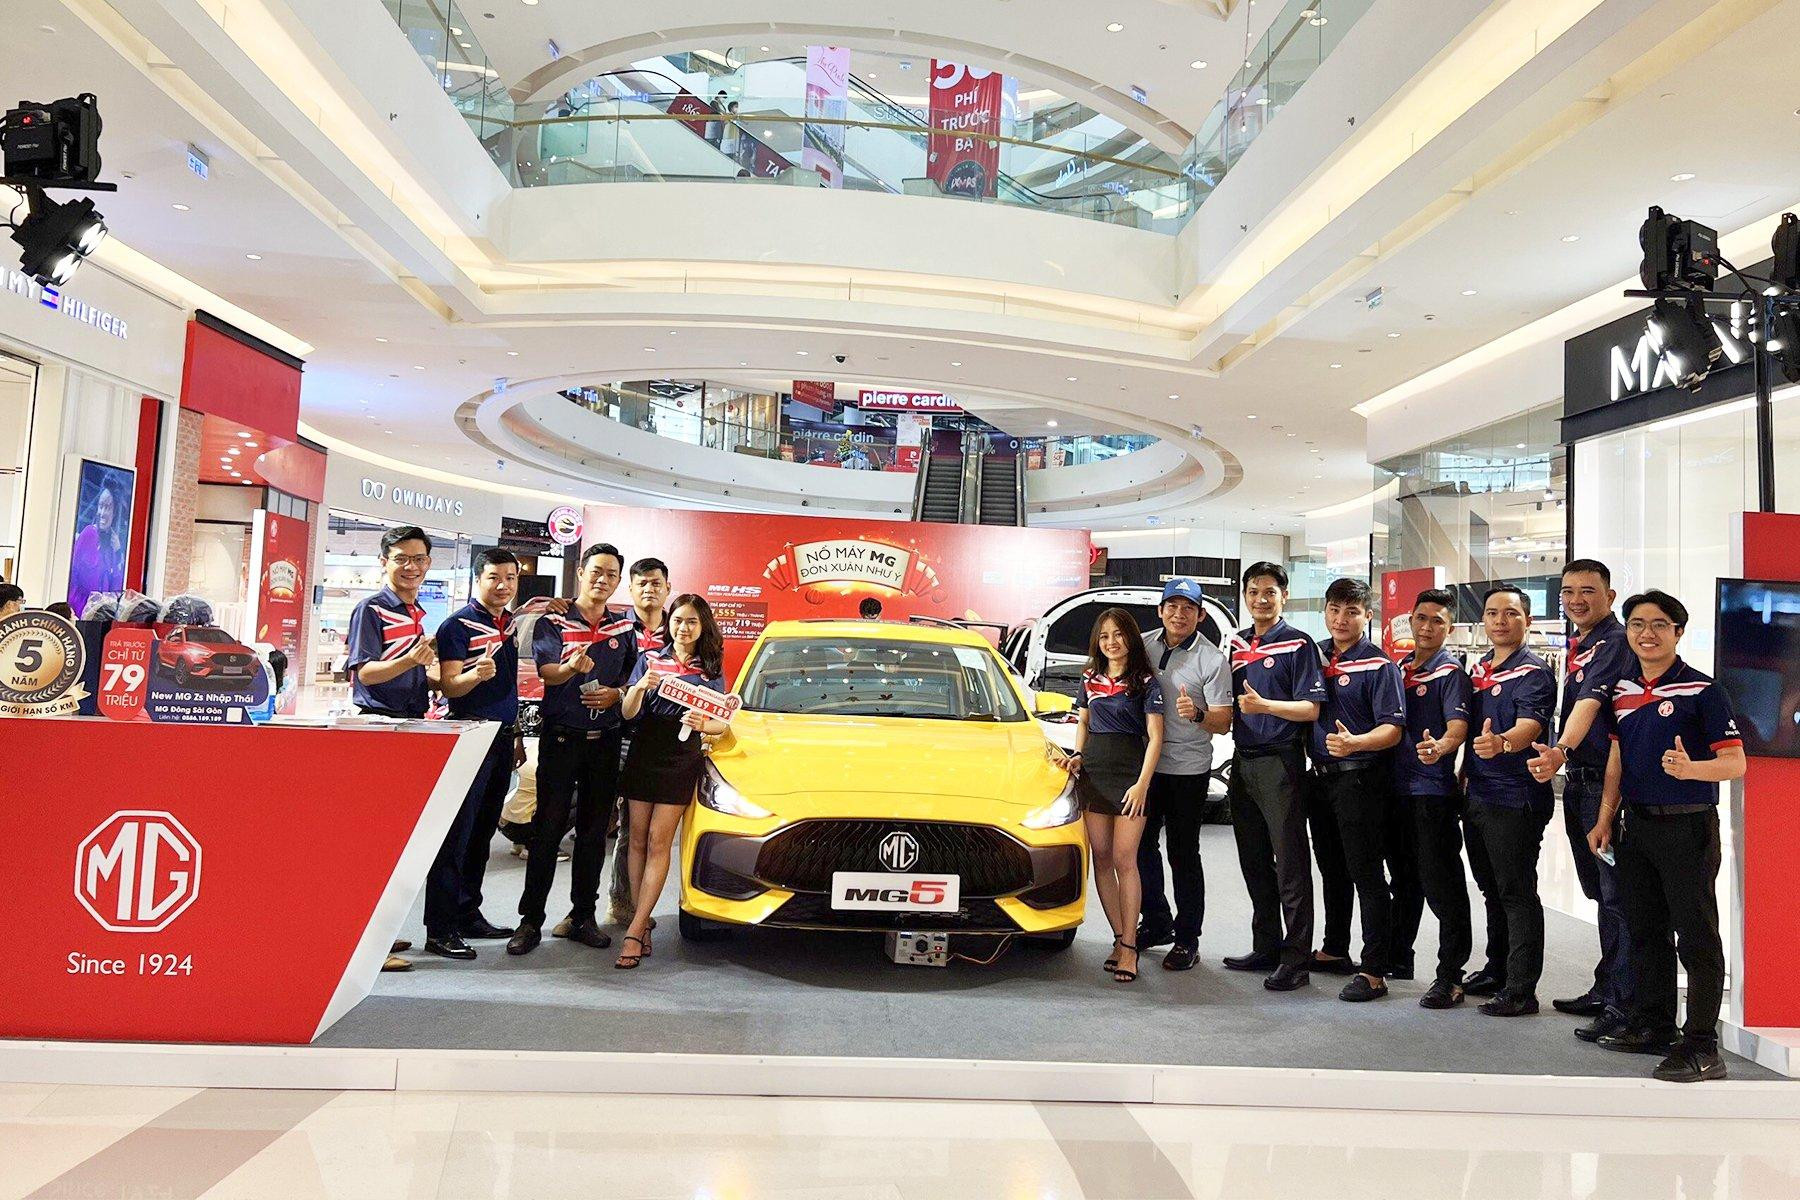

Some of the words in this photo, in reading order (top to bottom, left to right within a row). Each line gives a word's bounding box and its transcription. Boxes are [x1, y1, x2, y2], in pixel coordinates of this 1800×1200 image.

[955, 86, 979, 108] PHÍ
[941, 108, 990, 131] TRƯỚC
[955, 138, 974, 153] BẠ
[62, 295, 128, 340] HILFIGER
[862, 391, 908, 406] pierre
[392, 487, 464, 517] OWNDAYS
[806, 545, 831, 564] NỔ
[836, 545, 866, 559] MÁY
[870, 550, 897, 567] MG
[866, 565, 893, 579] NHƯ
[731, 585, 762, 594] HS
[32, 618, 66, 638] CHÍNH
[735, 619, 751, 627] 719
[14, 638, 43, 673] 5
[108, 649, 129, 661] CHỈ
[131, 650, 146, 661] TỪ
[11, 675, 38, 686] NĂM
[102, 663, 146, 692] 79
[670, 679, 697, 694] Hotline
[105, 694, 138, 708] TRIỆU
[151, 691, 173, 700] New
[175, 692, 192, 701] MG
[193, 693, 204, 701] Zs
[206, 693, 231, 704] Nhập
[234, 694, 254, 703] Thái
[664, 685, 689, 702] 0586
[692, 697, 710, 710] 189
[713, 705, 731, 718] 189
[0, 704, 20, 714] GIỚI
[22, 707, 42, 717] HẠN
[45, 702, 58, 714] SỐ
[60, 701, 74, 711] KM
[155, 705, 169, 713] MG
[170, 705, 191, 714] Đông
[192, 706, 205, 714] Sài
[882, 834, 915, 868] MG
[86, 821, 190, 921] MG
[844, 880, 948, 905] MG5
[66, 951, 126, 974] Since
[138, 953, 193, 976] 1924
